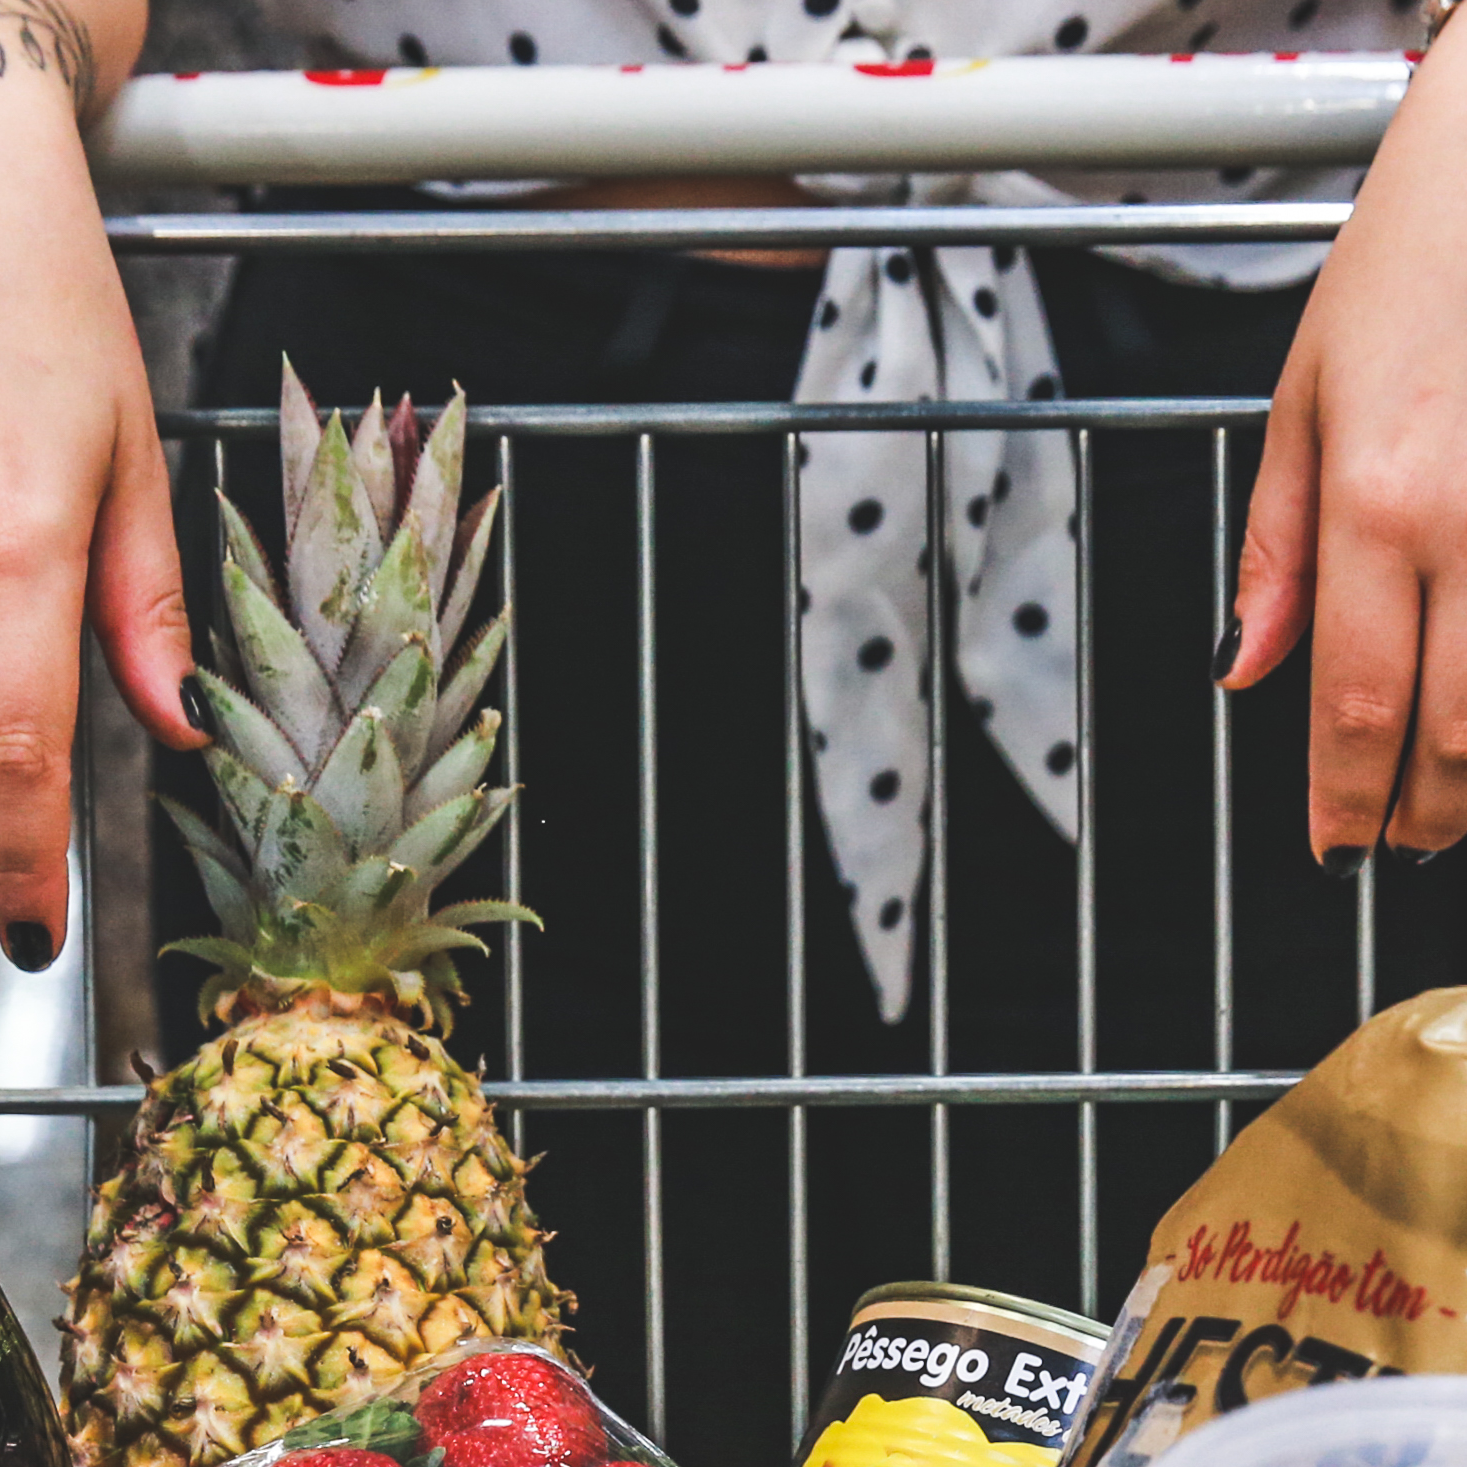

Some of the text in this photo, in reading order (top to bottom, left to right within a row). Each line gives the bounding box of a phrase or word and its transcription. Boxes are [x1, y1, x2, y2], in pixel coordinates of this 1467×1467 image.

[1213, 1219, 1354, 1320] Perdigão
[1354, 1248, 1428, 1322] tem
[836, 1324, 1089, 1415] Pêssego Ext
